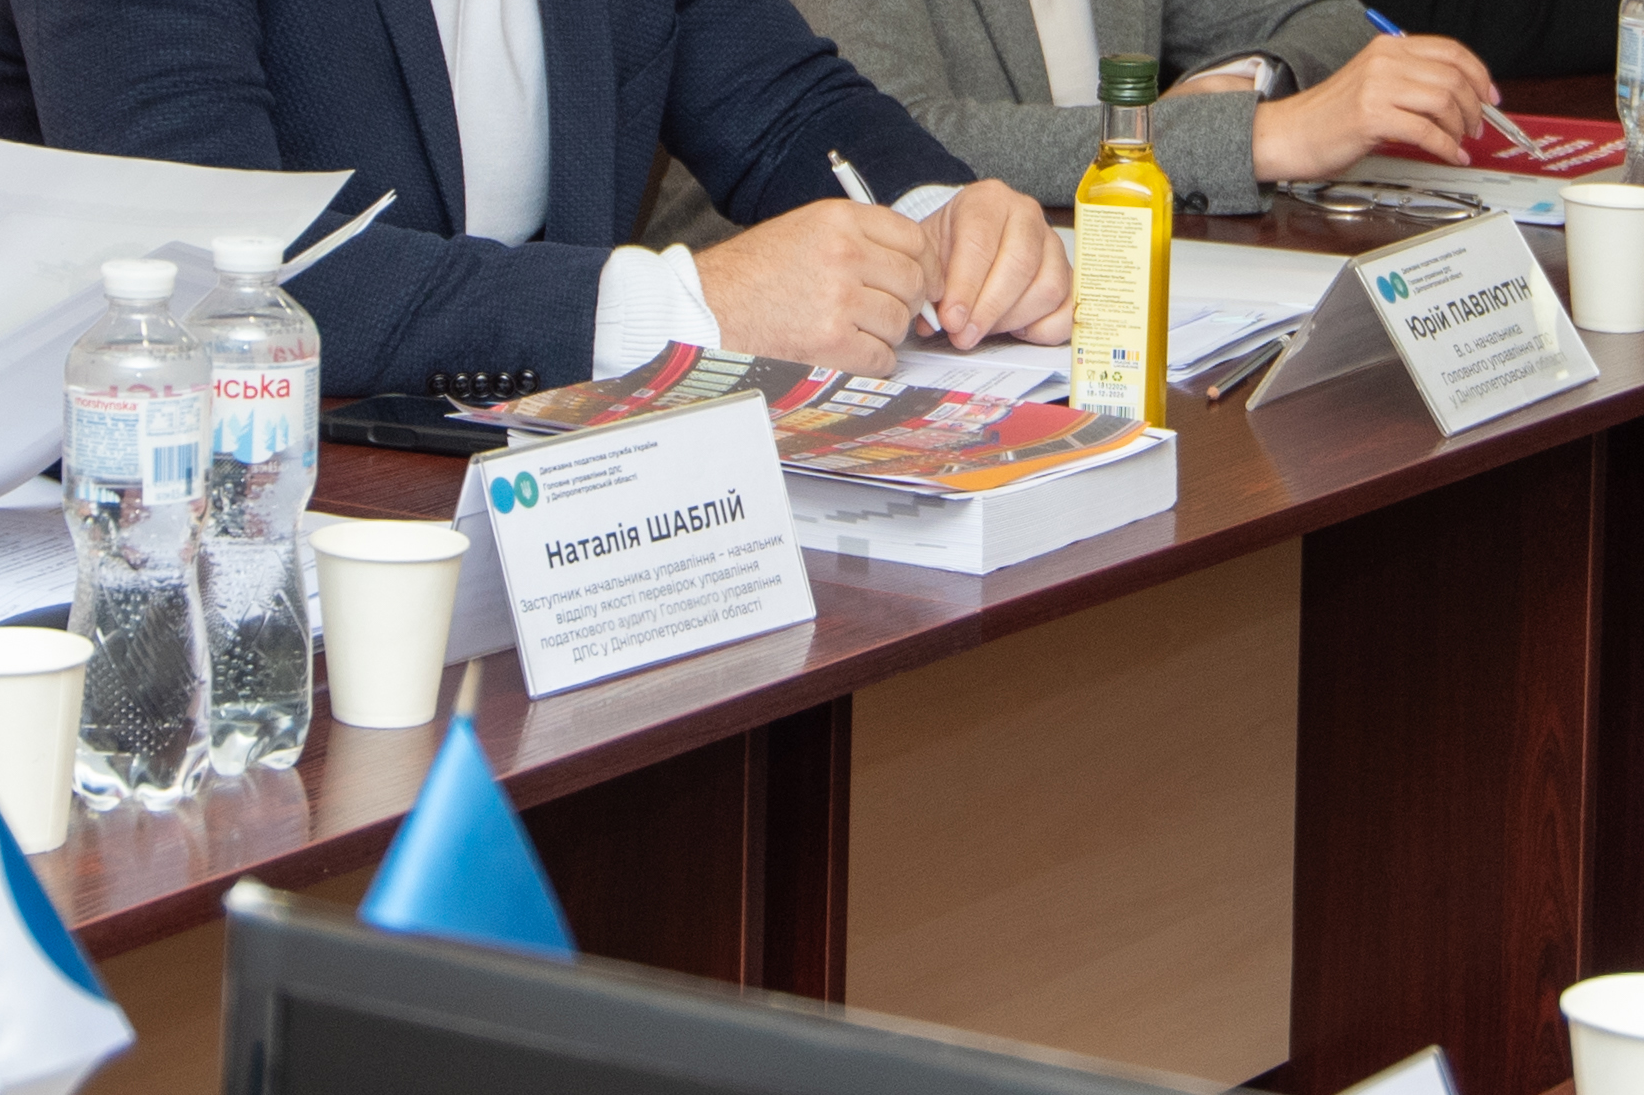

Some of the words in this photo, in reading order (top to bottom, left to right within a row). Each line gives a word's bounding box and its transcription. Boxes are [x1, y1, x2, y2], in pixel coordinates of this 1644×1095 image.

[1404, 304, 1452, 341] Юрій
[1446, 275, 1533, 325] ПАВЛЮТІН
[1440, 358, 1490, 385] Головного
[1489, 340, 1535, 371] управління
[1532, 332, 1555, 351] ДПС
[1452, 343, 1466, 358] В.
[1464, 342, 1475, 354] о.
[1472, 323, 1524, 351] начальника
[1448, 395, 1458, 409] у
[1455, 360, 1538, 405] Дніпропетровській
[539, 461, 573, 476] Державна
[574, 453, 608, 468] податкова
[608, 446, 633, 459] служба
[633, 440, 658, 453] України
[543, 478, 571, 491] Головне
[571, 469, 608, 486] управління
[608, 464, 623, 476] ДПС
[551, 479, 613, 502] Дніпропетровській
[613, 473, 638, 486] області
[544, 521, 641, 570] Наталія
[645, 487, 746, 543] ШАБЛІЙ
[519, 586, 583, 614] Заступник
[584, 568, 652, 596] начальника
[652, 551, 717, 582] управління
[727, 533, 785, 560] начальник
[555, 602, 598, 626] відділу
[600, 589, 637, 613] якості
[638, 577, 698, 603] перевірок
[698, 559, 761, 590] управління
[540, 618, 616, 651] податкового
[617, 607, 658, 631] аудиту
[659, 591, 720, 618] Головного
[720, 573, 783, 604] управління
[572, 642, 600, 664] ДПС
[601, 641, 609, 657] у
[610, 608, 721, 653] Дніпропетровській
[721, 596, 763, 621] області
